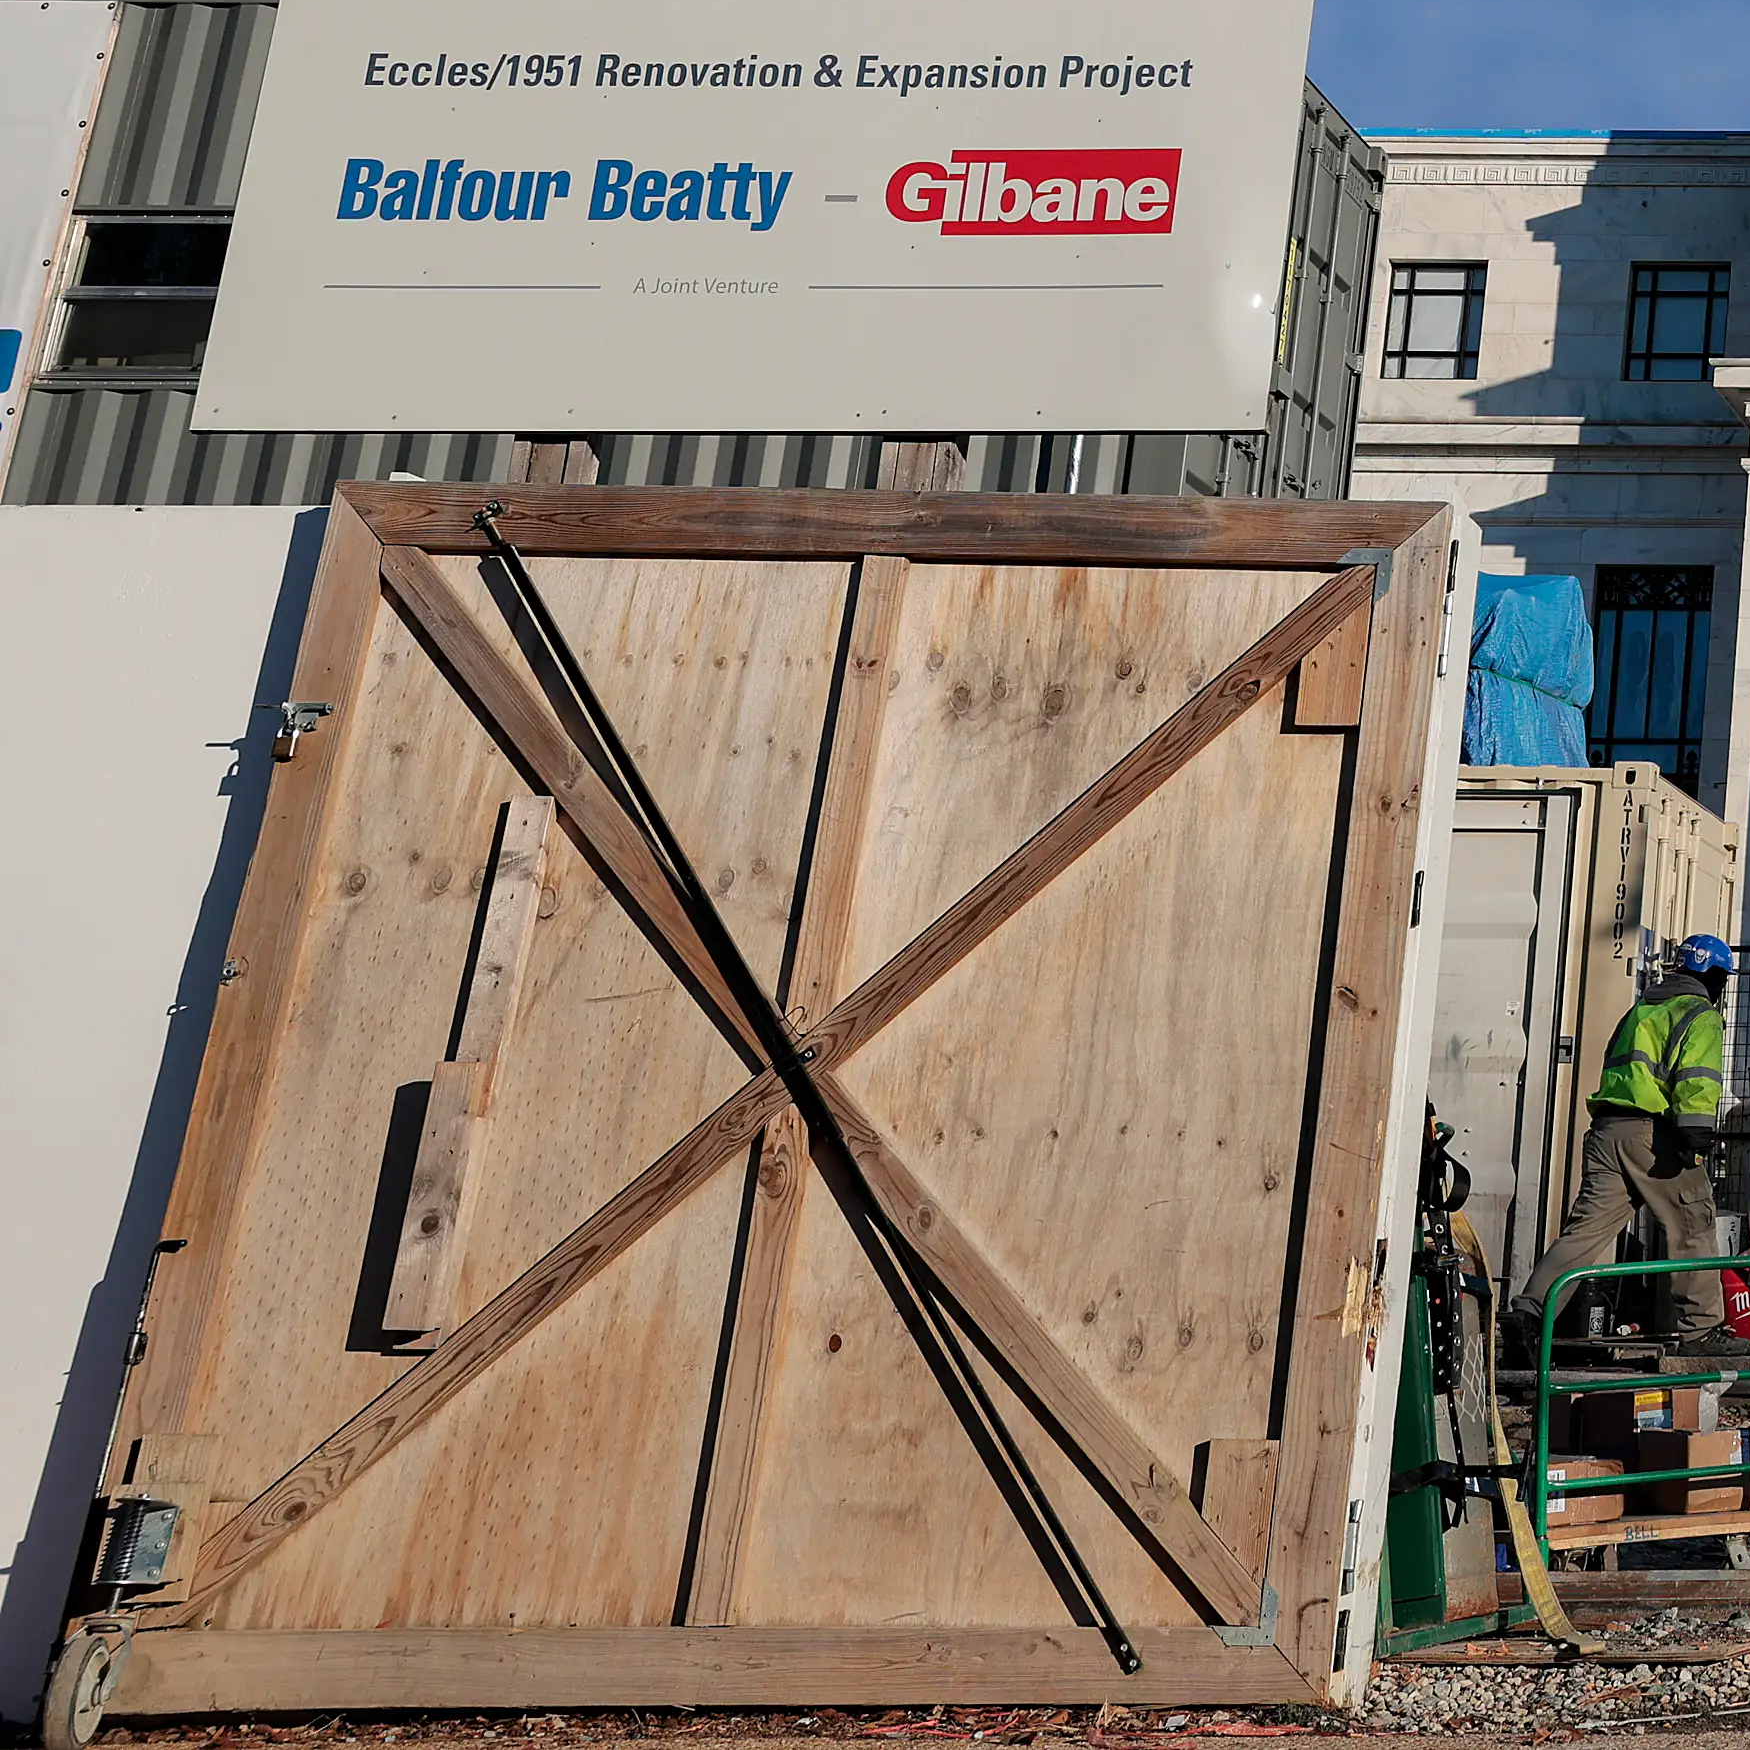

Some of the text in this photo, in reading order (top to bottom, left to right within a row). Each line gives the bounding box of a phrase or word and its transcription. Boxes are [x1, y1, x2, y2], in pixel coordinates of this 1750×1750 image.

[364, 52, 1194, 98] Eccles/1951 Renovation & Expansion Project
[336, 158, 793, 231] Balfour Beatty
[885, 160, 1171, 223] Gilbane
[633, 277, 779, 294] A Joint Venture
[1623, 1525, 1659, 1542] BELL
